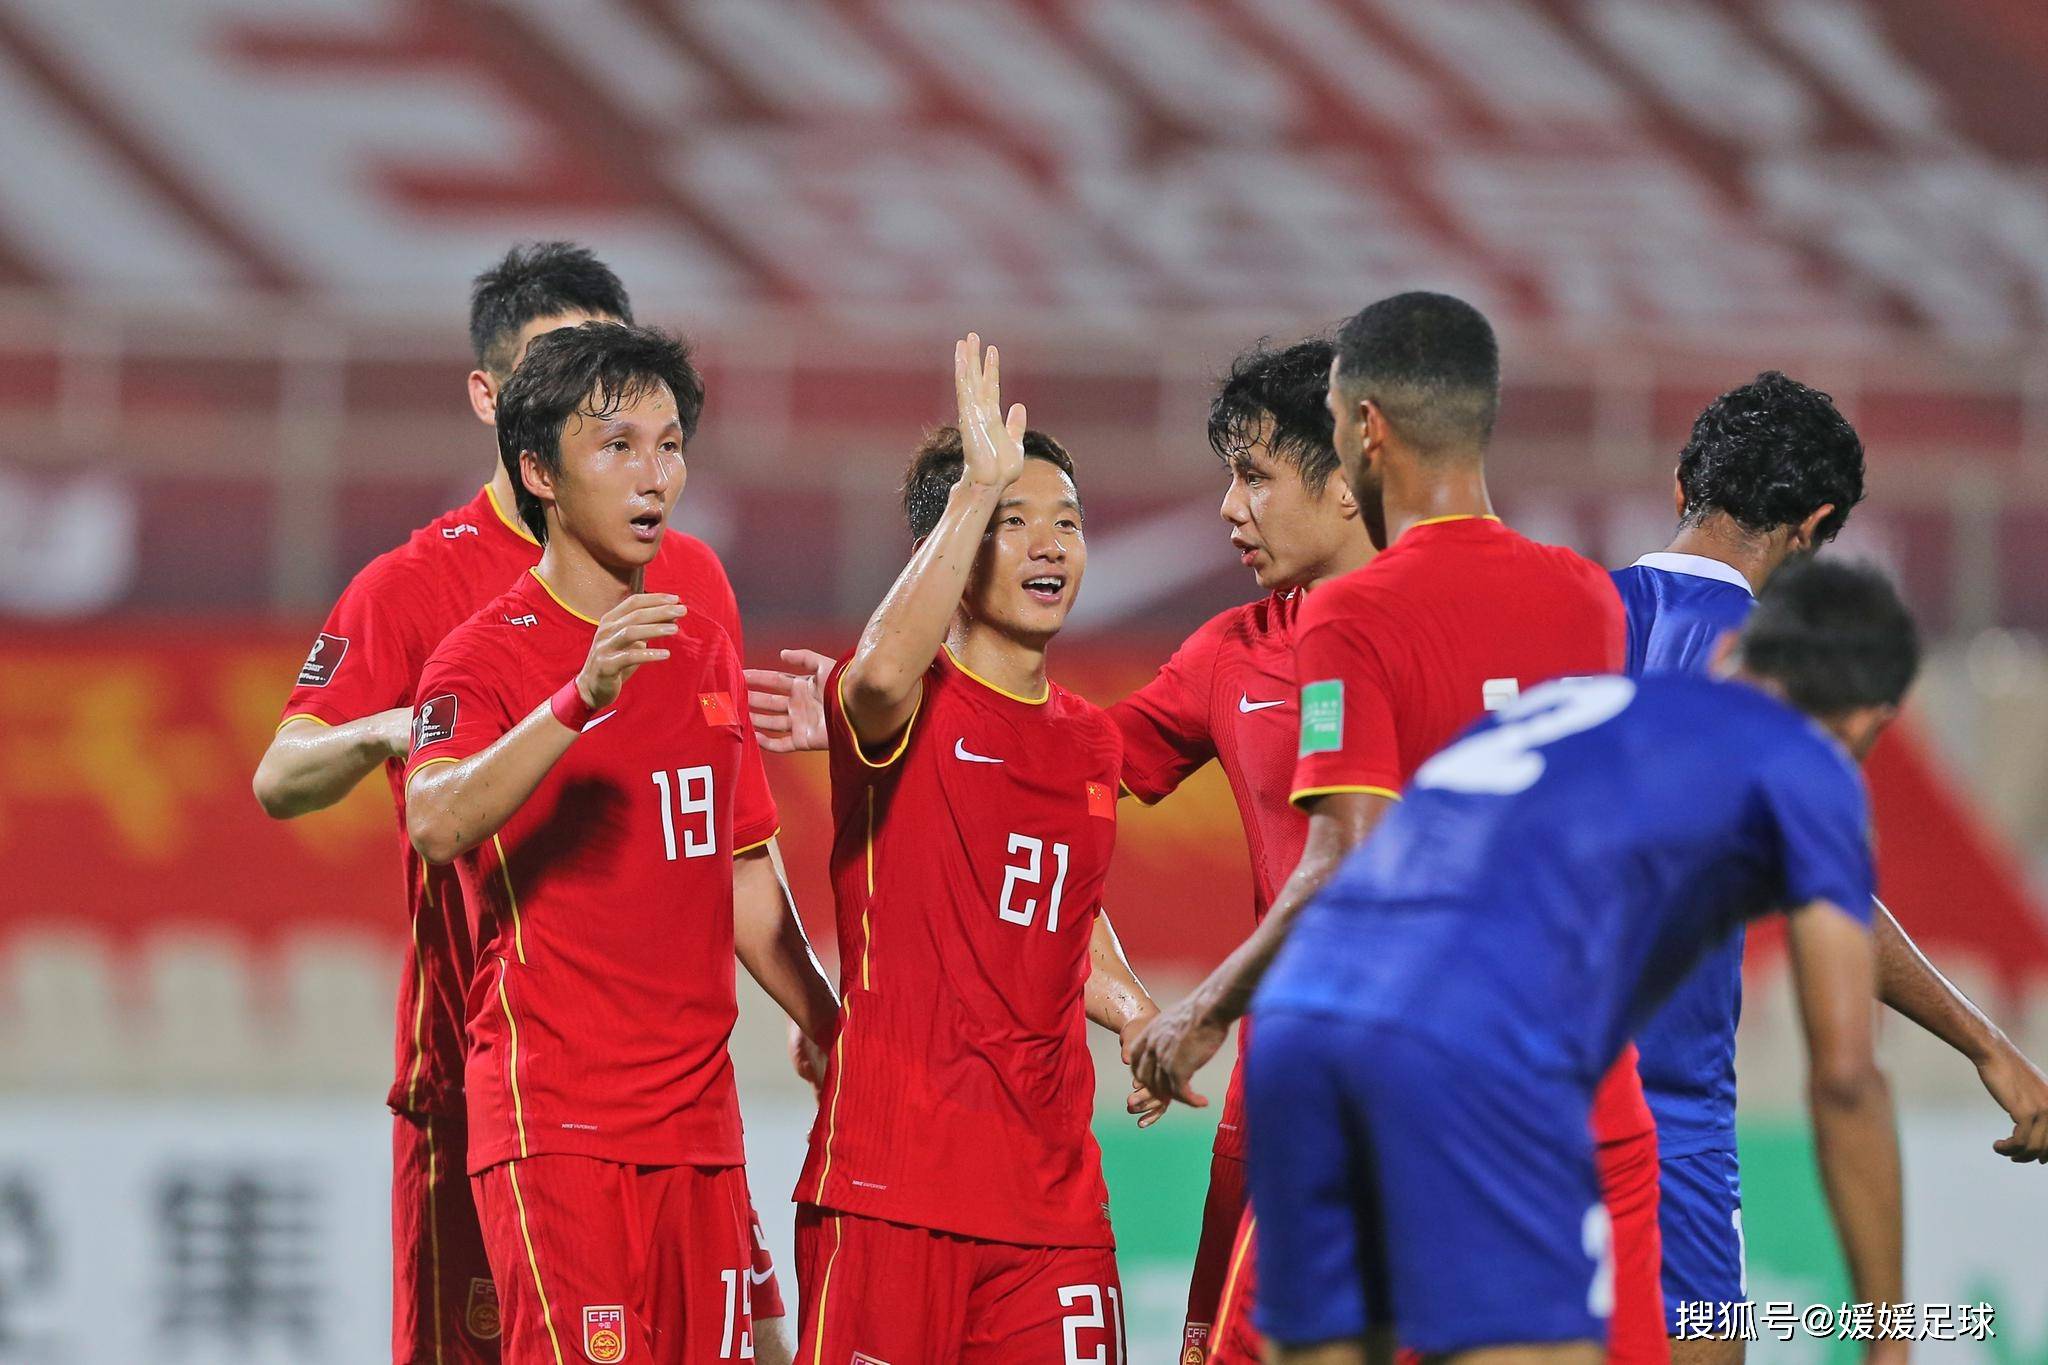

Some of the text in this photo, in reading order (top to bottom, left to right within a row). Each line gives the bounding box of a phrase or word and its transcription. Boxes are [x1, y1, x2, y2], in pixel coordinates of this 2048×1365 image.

[1414, 673, 1636, 796] 2
[651, 765, 717, 861] 19
[998, 832, 1069, 933] 21
[588, 1311, 620, 1322] CFA
[1057, 1284, 1126, 1365] 21
[1187, 1328, 1207, 1339] CFA
